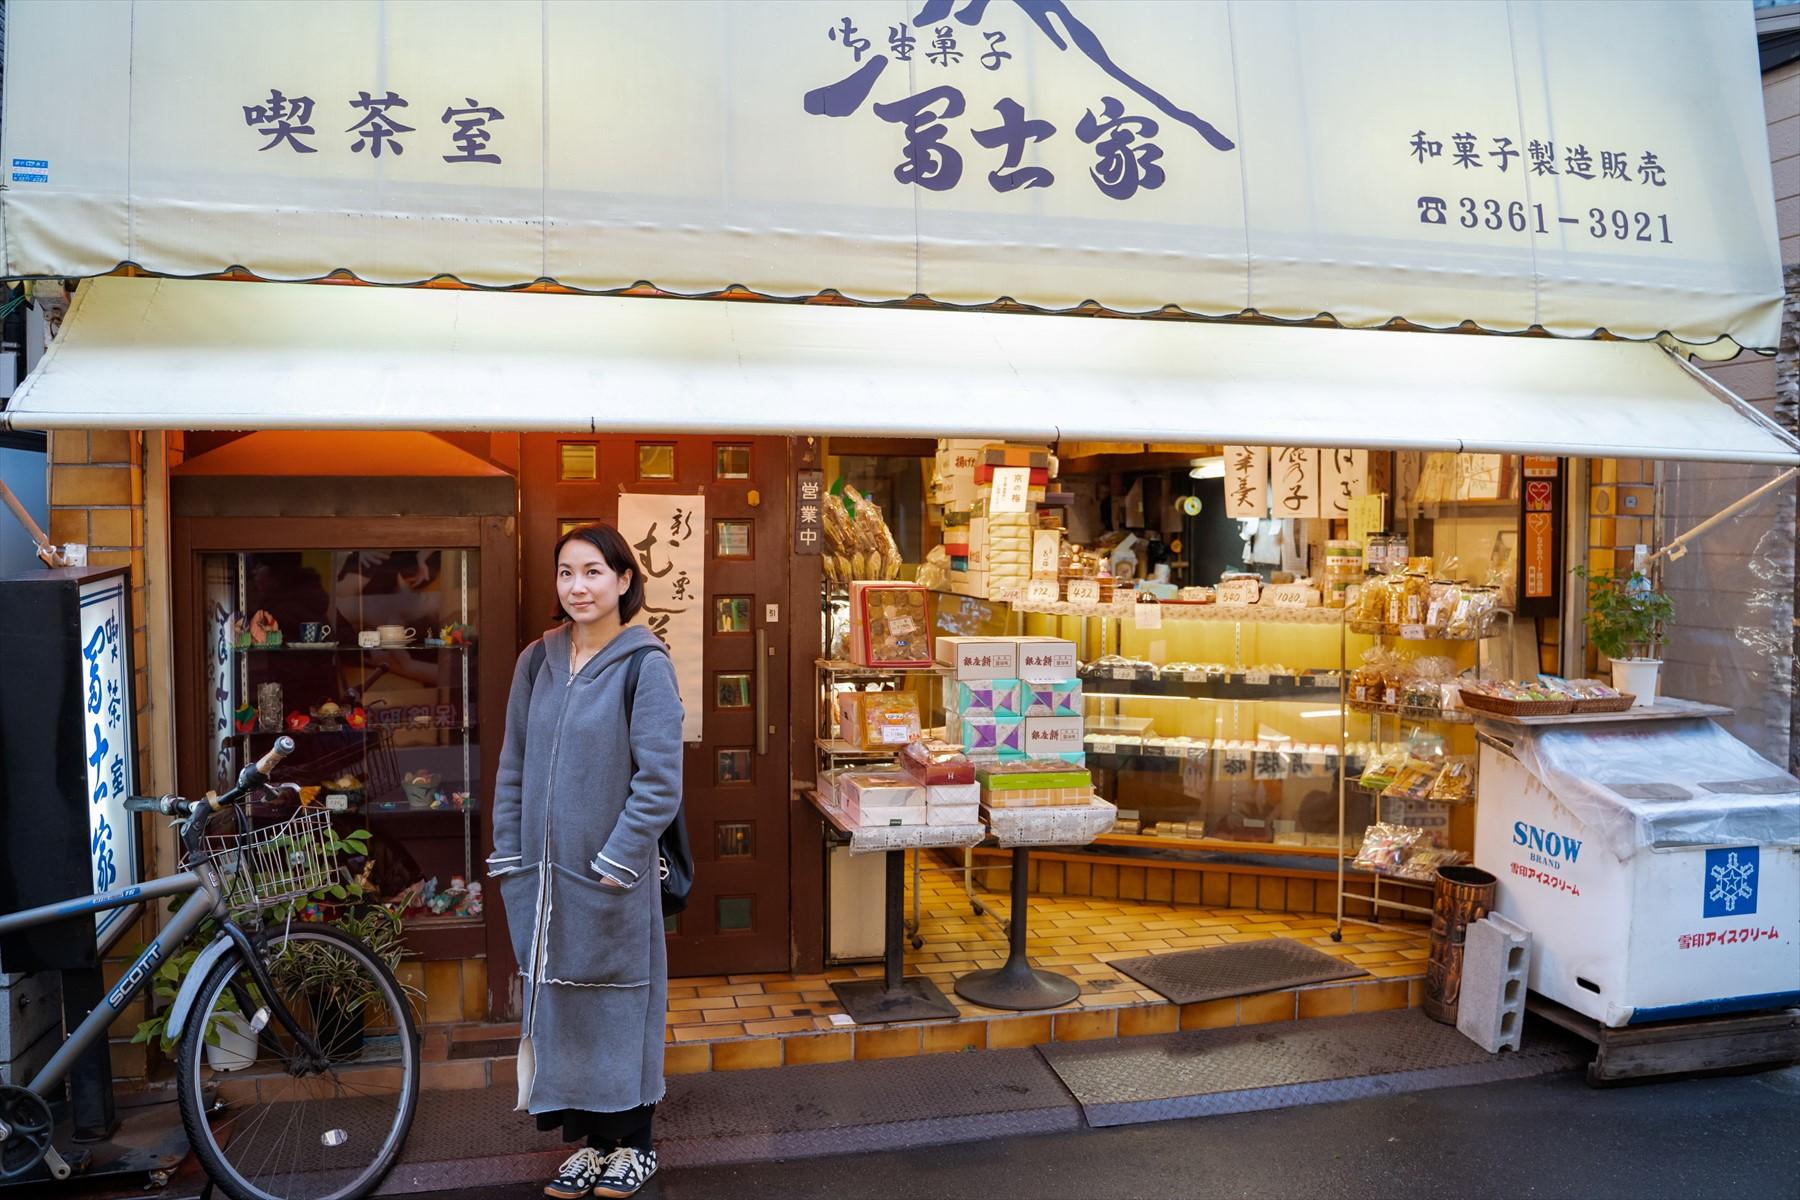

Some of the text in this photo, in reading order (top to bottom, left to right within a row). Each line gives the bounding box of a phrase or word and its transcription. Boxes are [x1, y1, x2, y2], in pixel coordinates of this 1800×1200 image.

[829, 16, 1012, 70] 御生菓子
[243, 89, 504, 164] 喫茶室
[1410, 129, 1667, 186] 和菓子製造販売
[1460, 196, 1674, 244] 3361-3921
[800, 481, 819, 546] 営業中
[1073, 587, 1093, 598] 432
[105, 609, 125, 799] 喫茶室
[1513, 821, 1582, 864] SNOW
[1530, 853, 1560, 869] BRAND
[1510, 862, 1580, 896] 雪印アイスクリーム
[1678, 925, 1779, 949] 雪印アイスクリーム
[109, 944, 161, 1007] SCOTT
